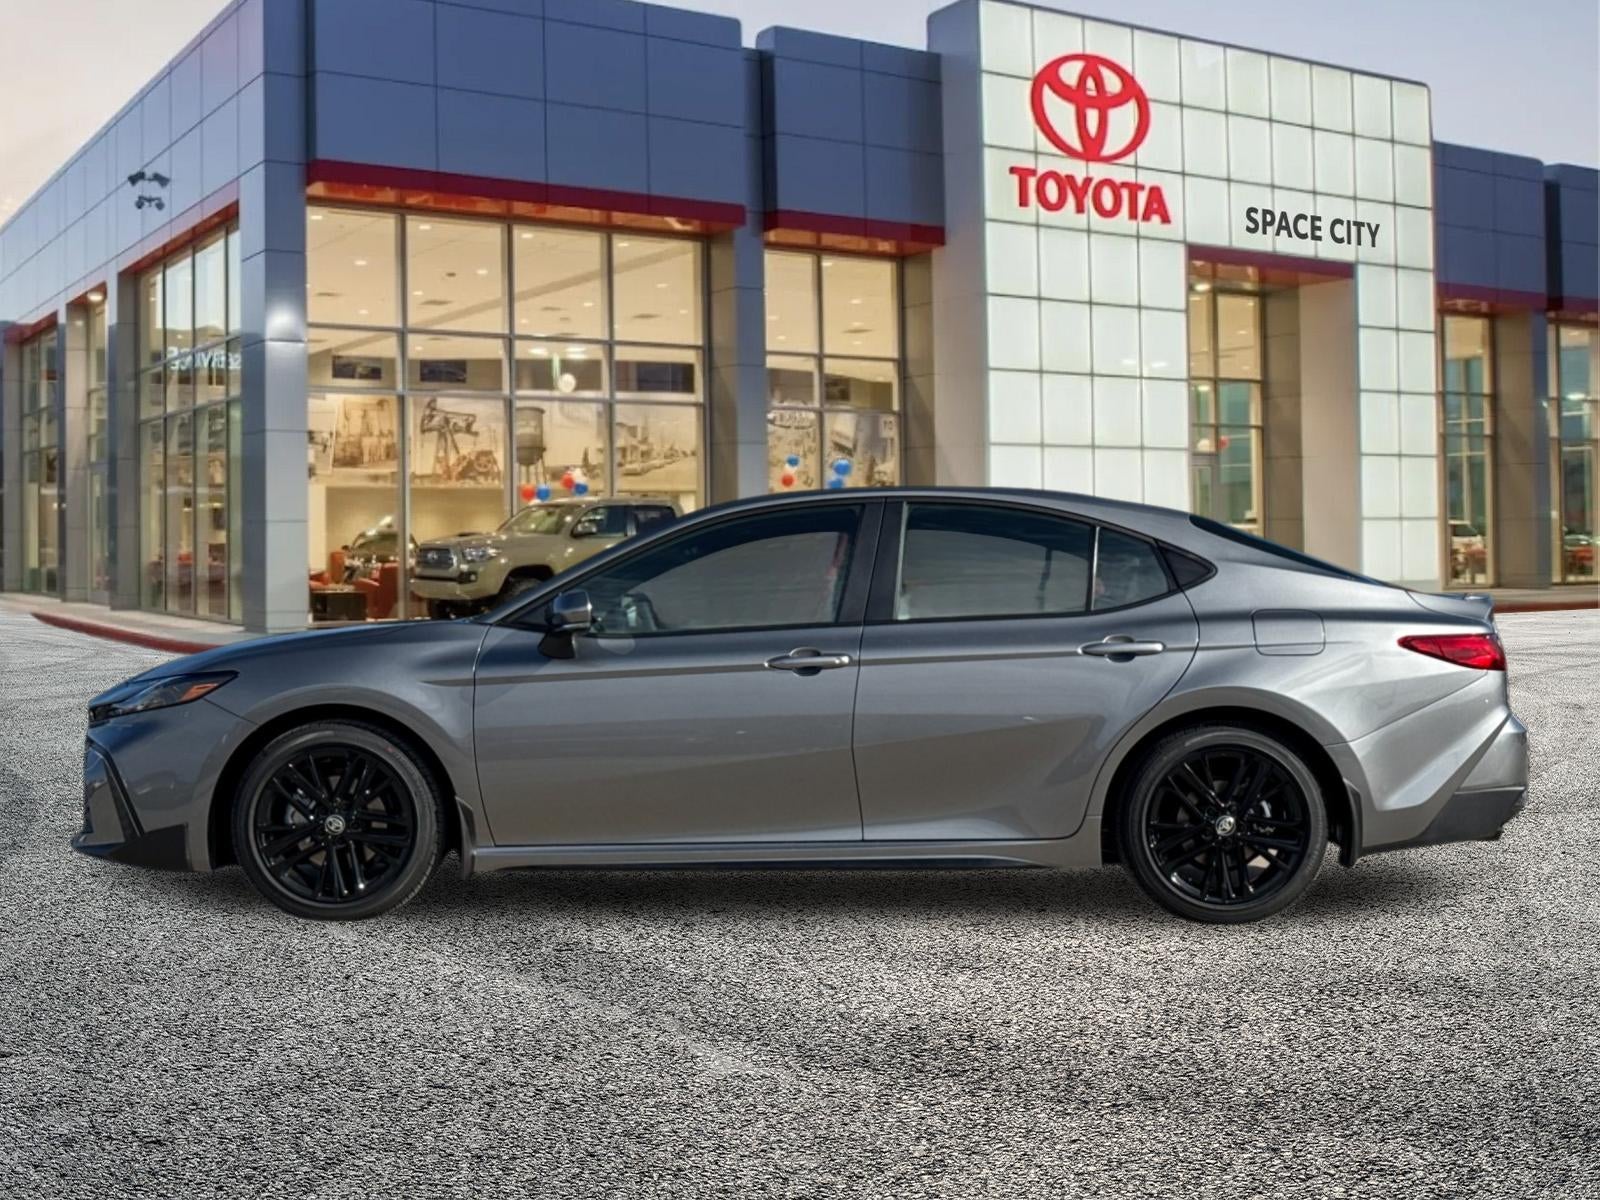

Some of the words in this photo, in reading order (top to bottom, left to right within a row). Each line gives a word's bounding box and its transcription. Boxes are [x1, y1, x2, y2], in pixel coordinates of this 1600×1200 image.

[1009, 166, 1171, 224] TOYOTA
[1245, 206, 1323, 242] SPACE
[1329, 218, 1381, 248] CITY
